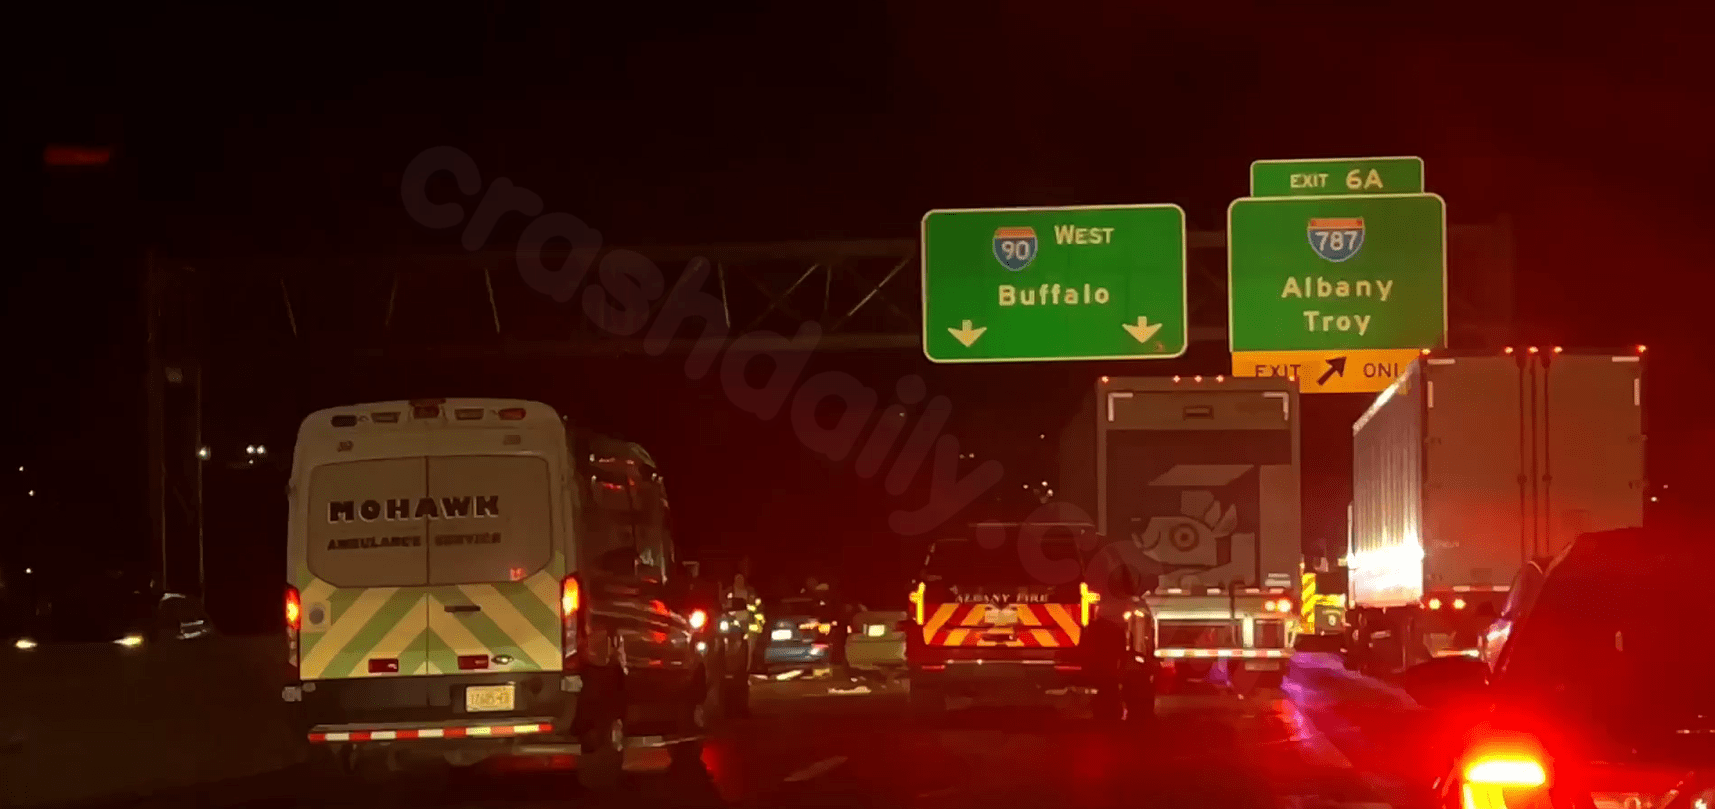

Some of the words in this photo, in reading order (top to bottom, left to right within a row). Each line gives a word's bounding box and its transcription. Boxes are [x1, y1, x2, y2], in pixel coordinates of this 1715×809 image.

[1290, 173, 1329, 189] EXIT
[1345, 169, 1383, 190] 6A
[1054, 225, 1115, 245] WEST
[1315, 230, 1358, 252] 787
[1001, 240, 1030, 261] 90
[998, 284, 1110, 307] Buffalo
[1281, 276, 1394, 302] Albany
[1303, 310, 1371, 336] Troy
[1255, 364, 1301, 378] EXIT
[1363, 362, 1401, 379] ONL
[328, 495, 499, 522] MOHAWK
[955, 593, 1010, 604] ALBANY
[1016, 592, 1049, 604] FIRE
